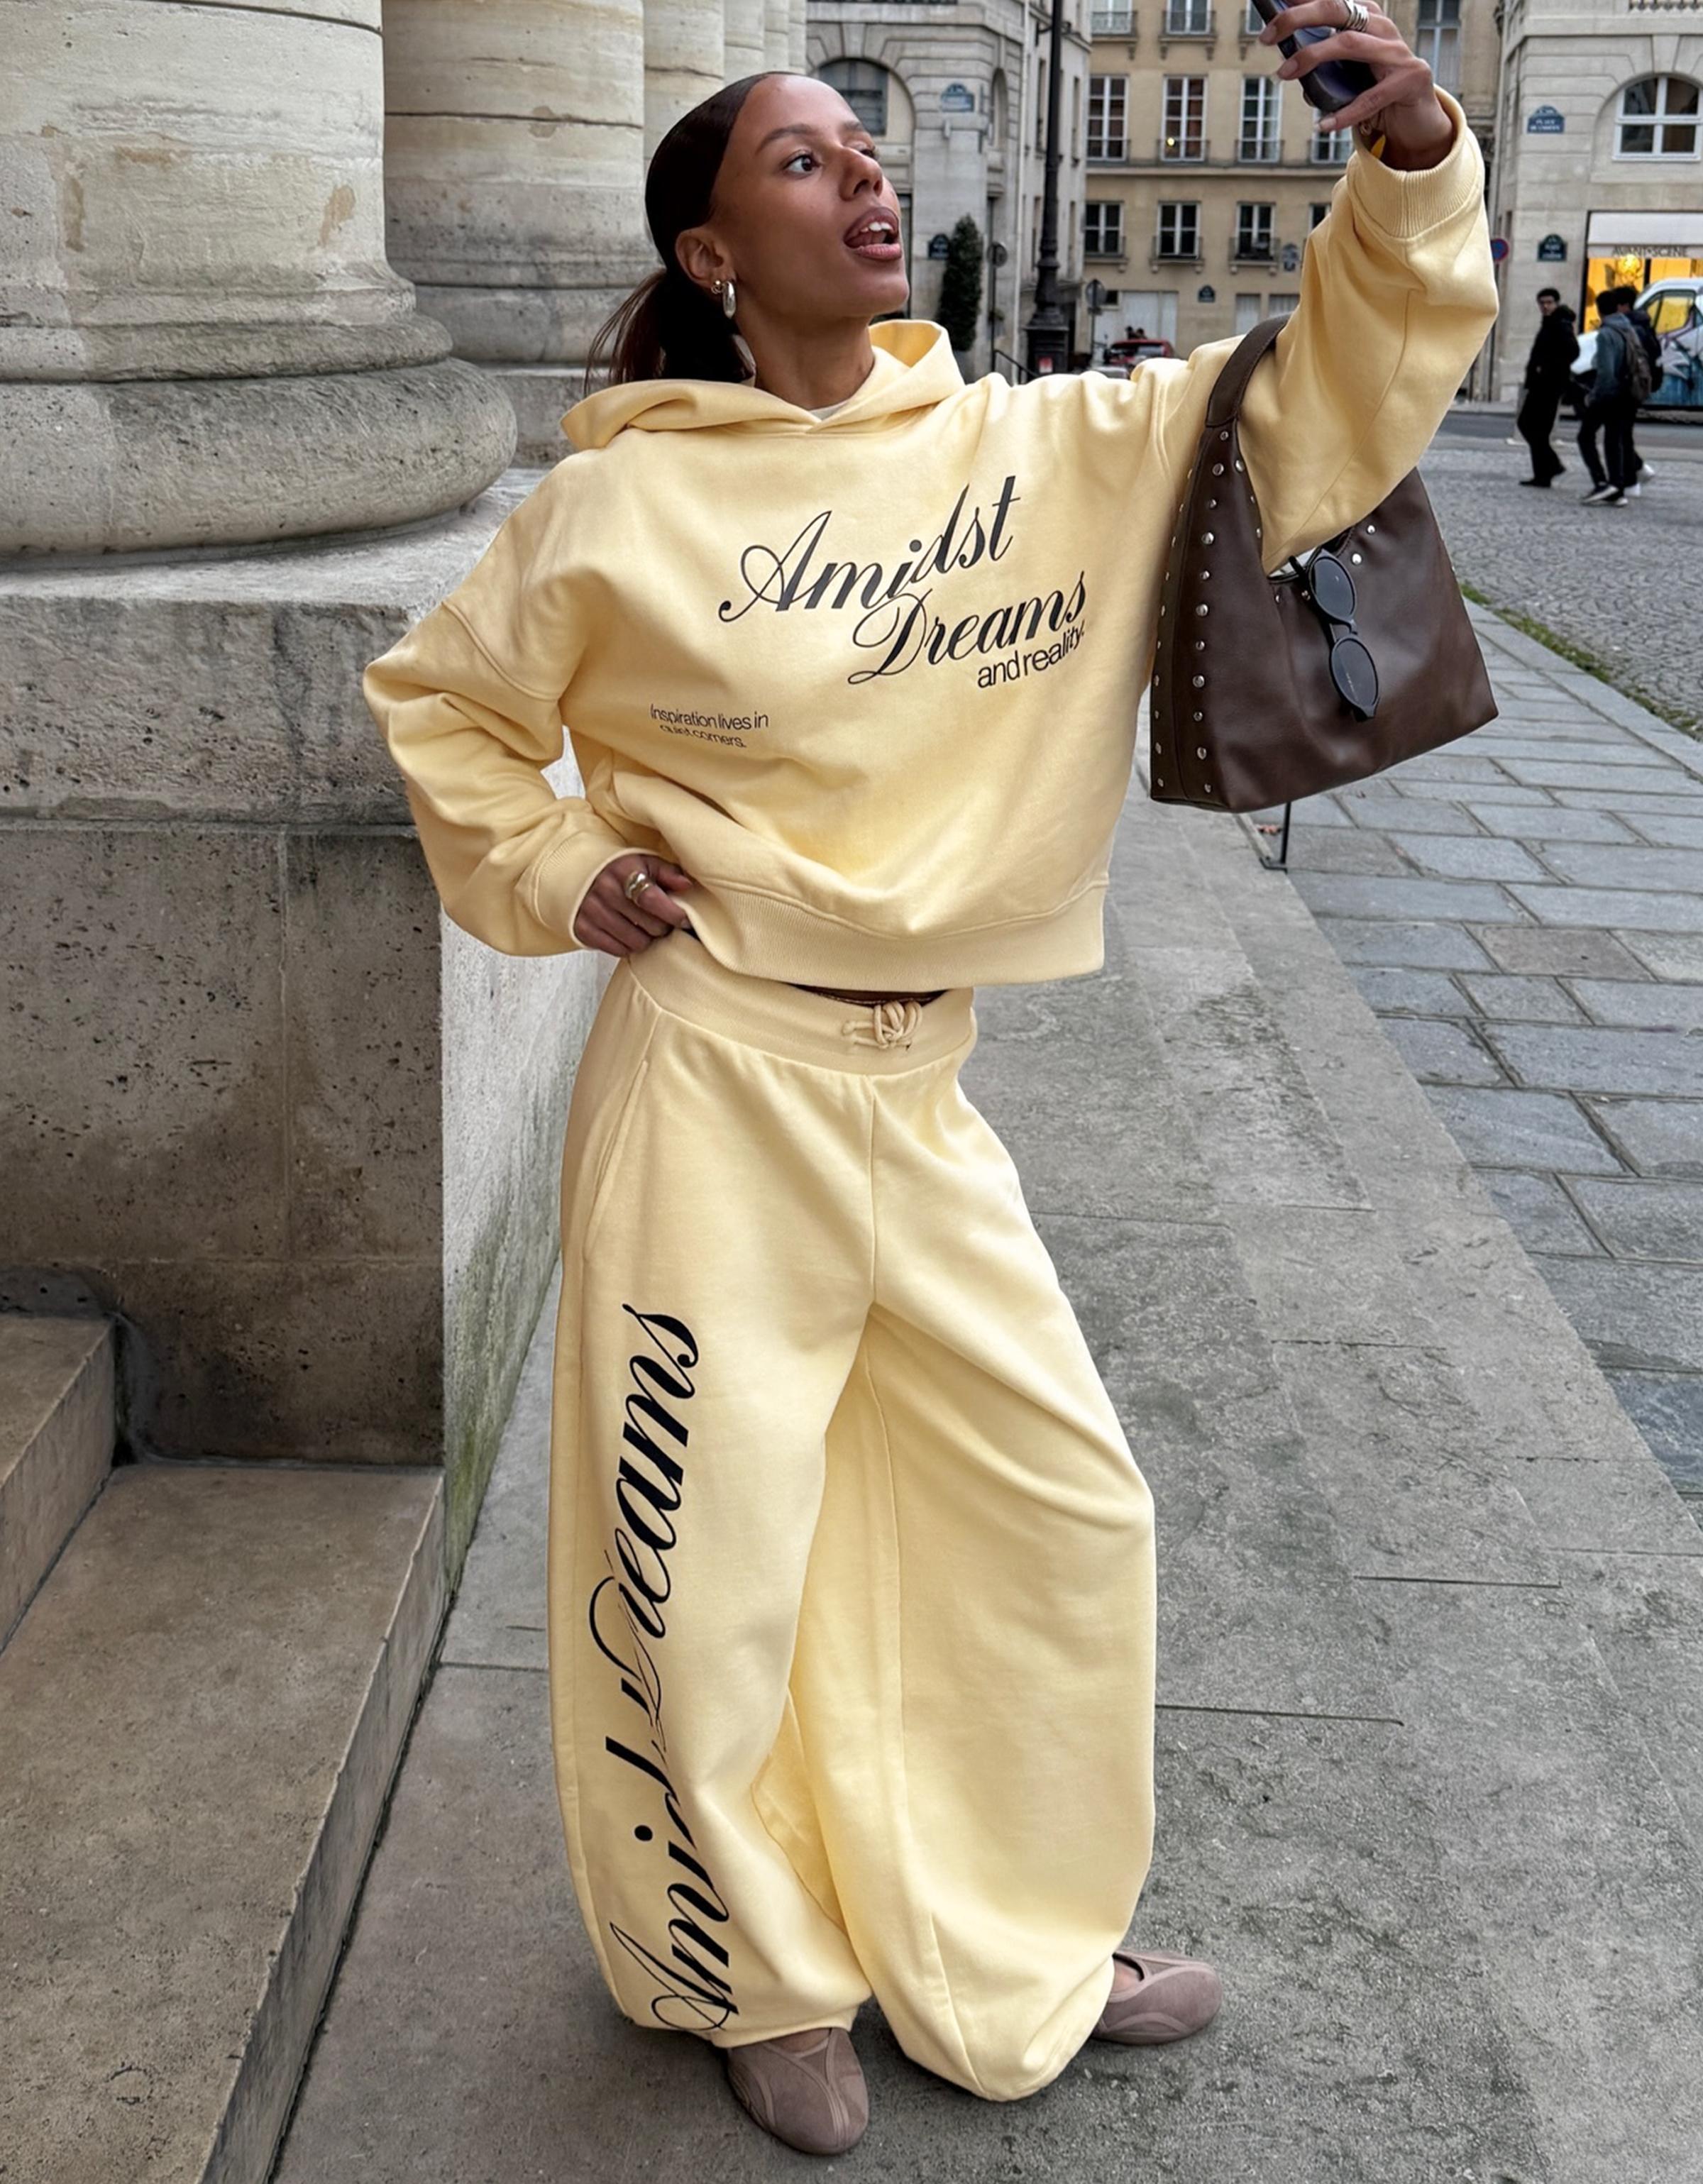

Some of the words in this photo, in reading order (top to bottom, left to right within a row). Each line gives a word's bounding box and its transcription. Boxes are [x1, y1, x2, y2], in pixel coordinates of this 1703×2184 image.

[718, 475, 1021, 623] Amidst
[847, 570, 1086, 685] Dreams
[977, 649, 1020, 688] and
[649, 703, 717, 729] Inspiration
[717, 712, 752, 731] lives
[754, 710, 769, 729] in
